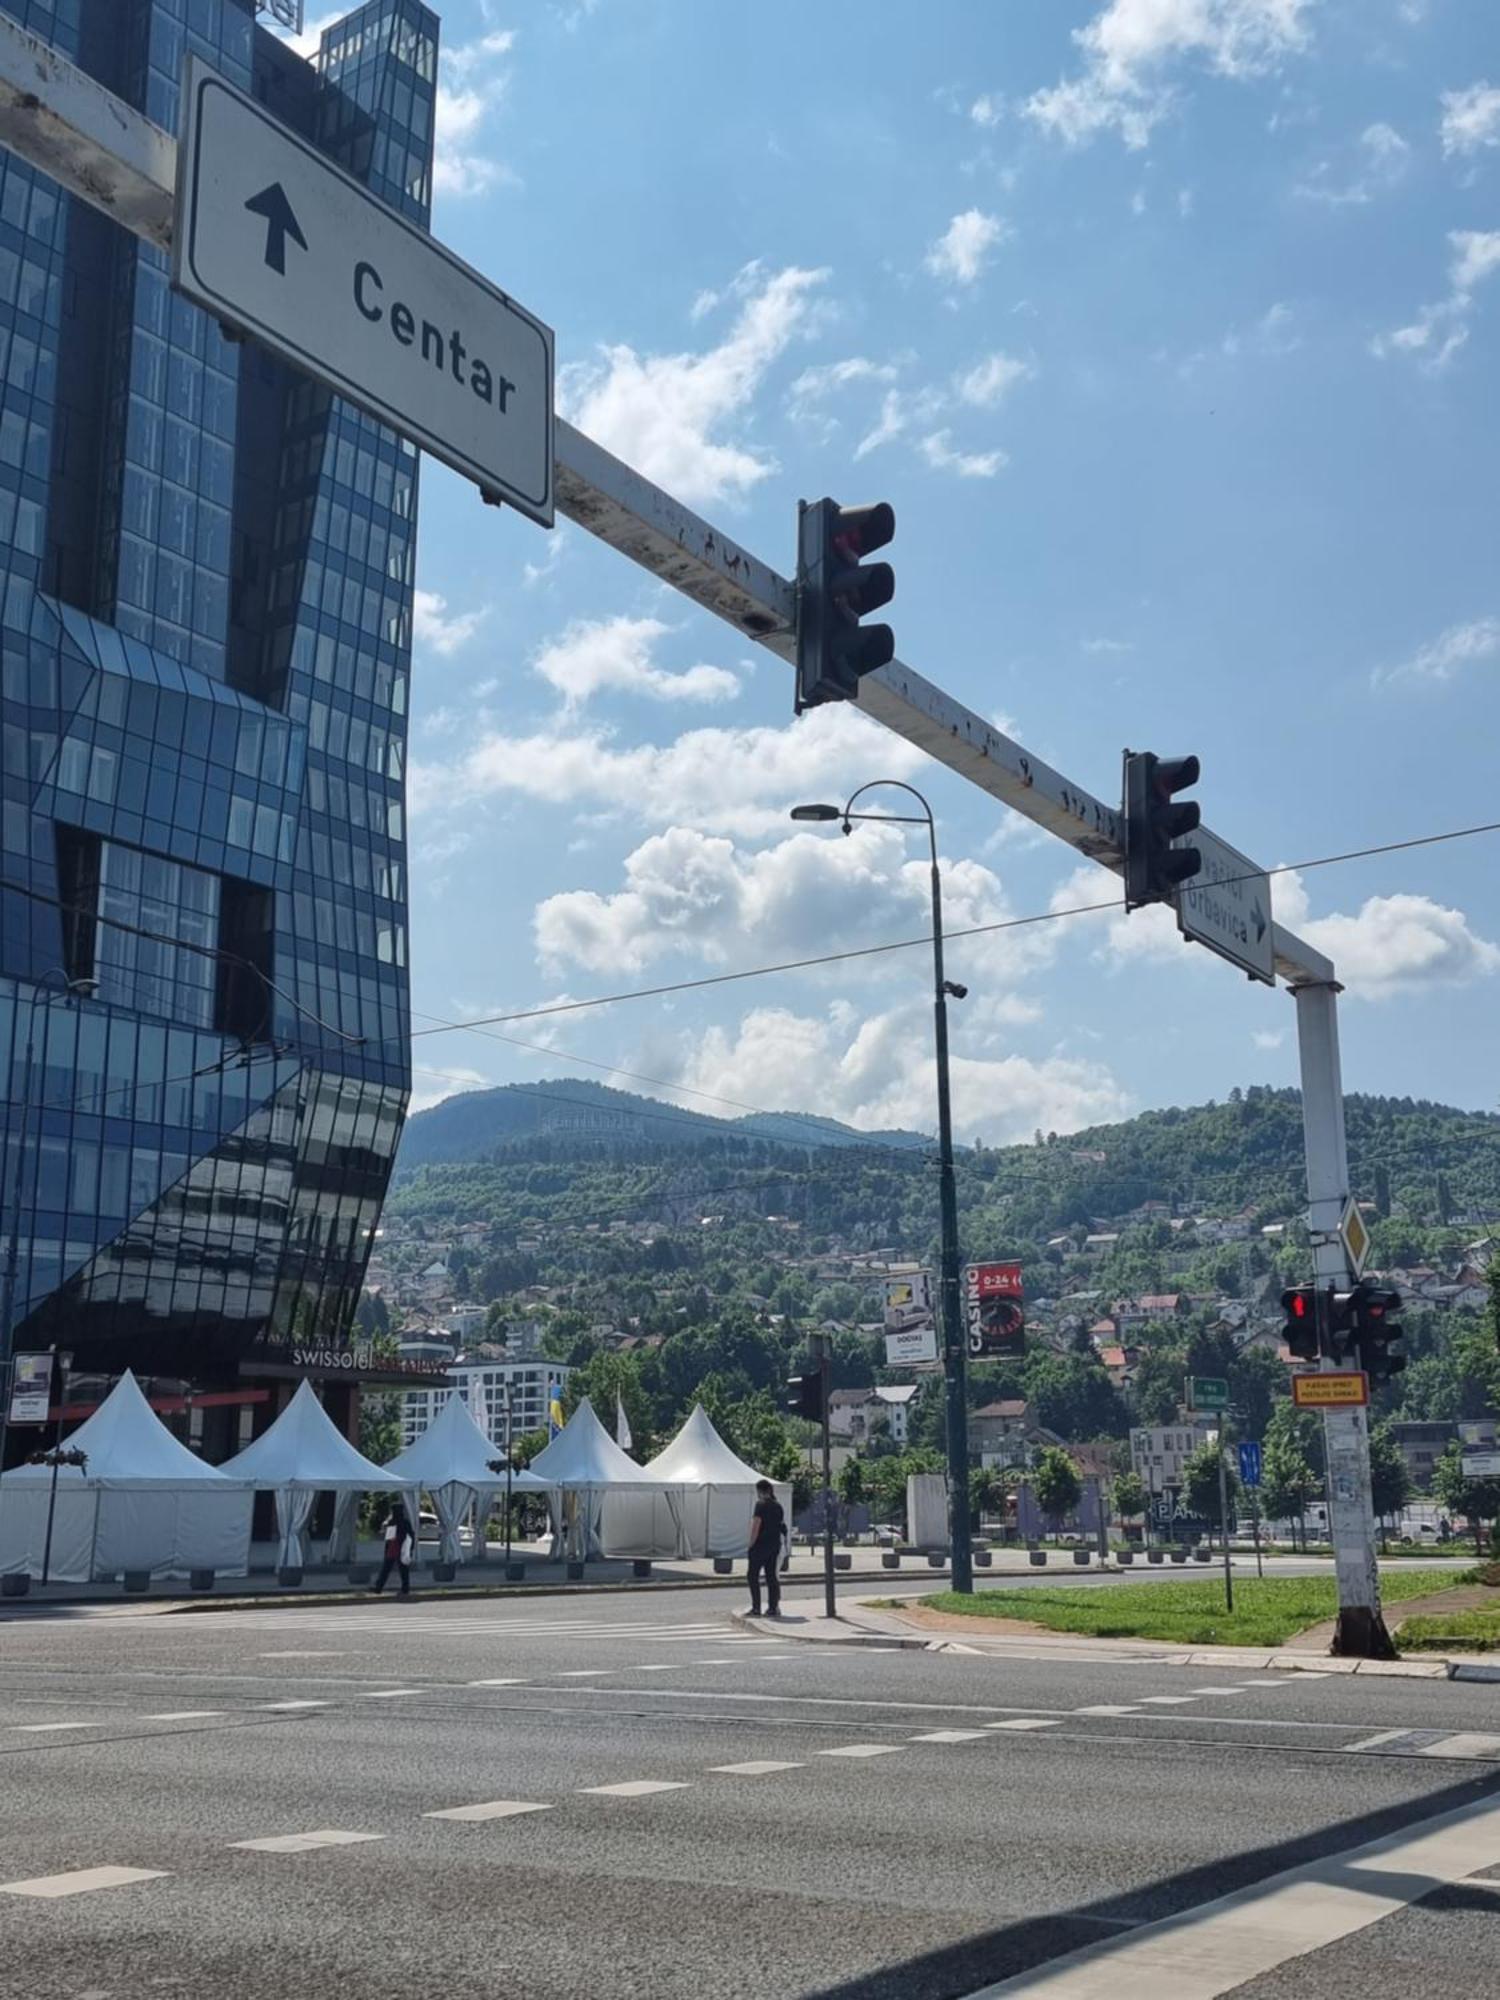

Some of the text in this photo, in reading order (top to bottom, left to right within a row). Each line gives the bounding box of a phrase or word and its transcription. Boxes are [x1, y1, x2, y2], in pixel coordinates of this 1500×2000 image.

[352, 260, 516, 415] Centar
[1187, 879, 1248, 944] Grbavica
[967, 1269, 983, 1352] CASINO
[983, 1275, 1010, 1285] 0-24
